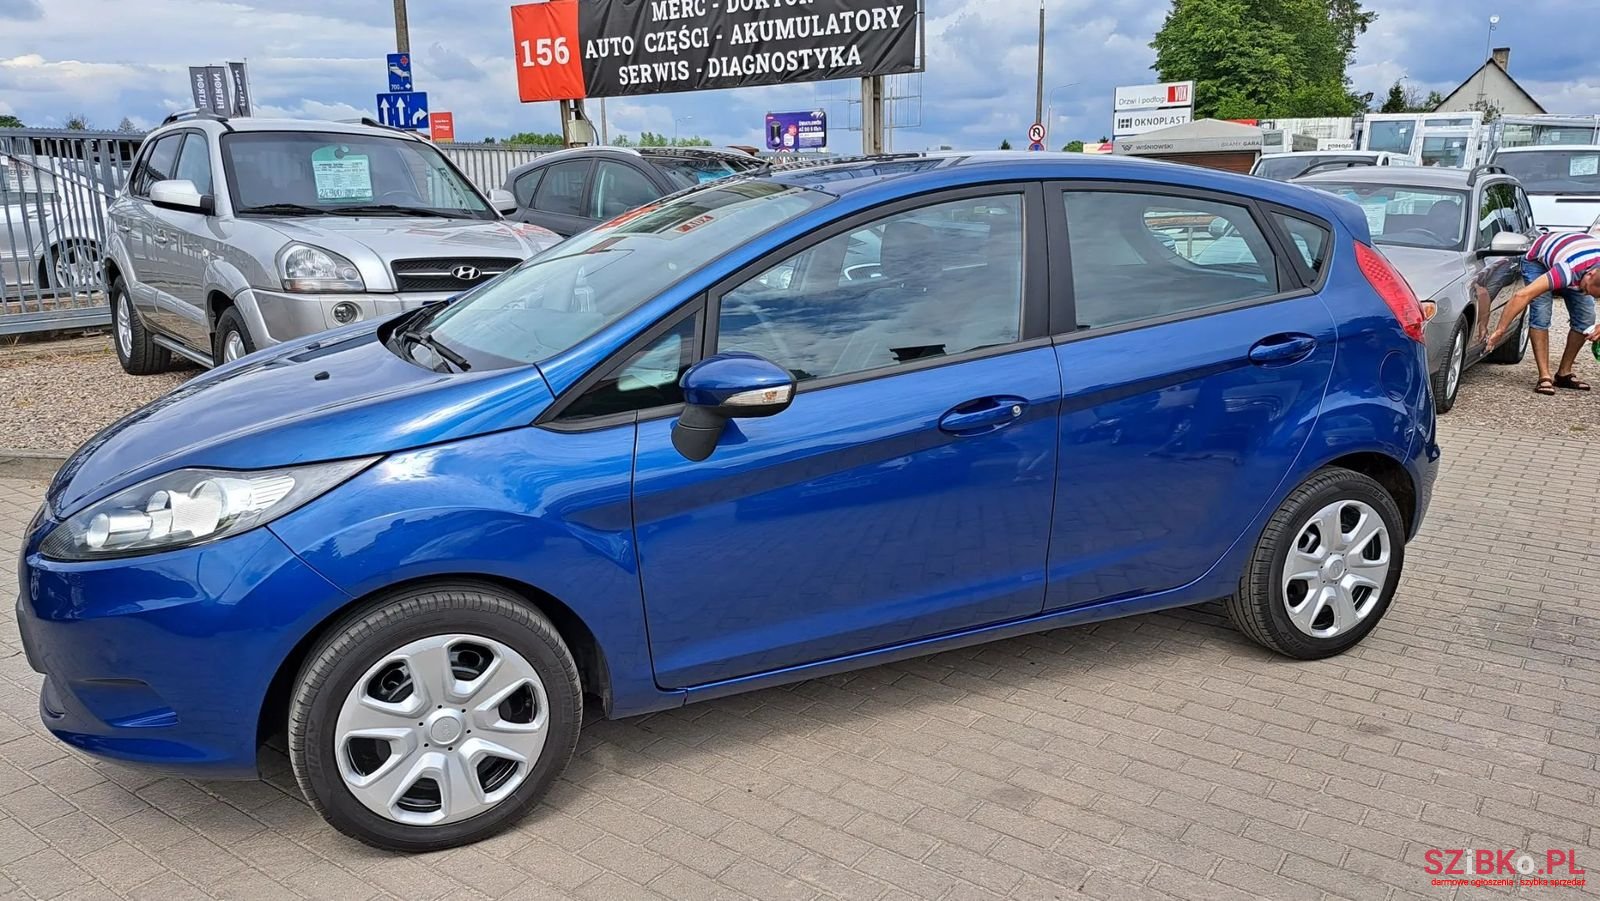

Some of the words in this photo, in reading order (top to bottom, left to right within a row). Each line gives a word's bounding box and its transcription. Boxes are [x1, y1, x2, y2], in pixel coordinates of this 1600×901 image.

[651, 0, 706, 22] MERC
[726, 0, 814, 14] DOK
[585, 36, 634, 59] AUTO
[644, 24, 710, 55] CZĘŚCI
[727, 5, 904, 46] AKUMULATORY
[520, 37, 570, 67] 156
[619, 60, 690, 86] SERWIS
[708, 44, 862, 78] DIAGNOSTYKA
[1119, 98, 1136, 106] Drzwi
[1134, 115, 1186, 127] OKNOPLAST
